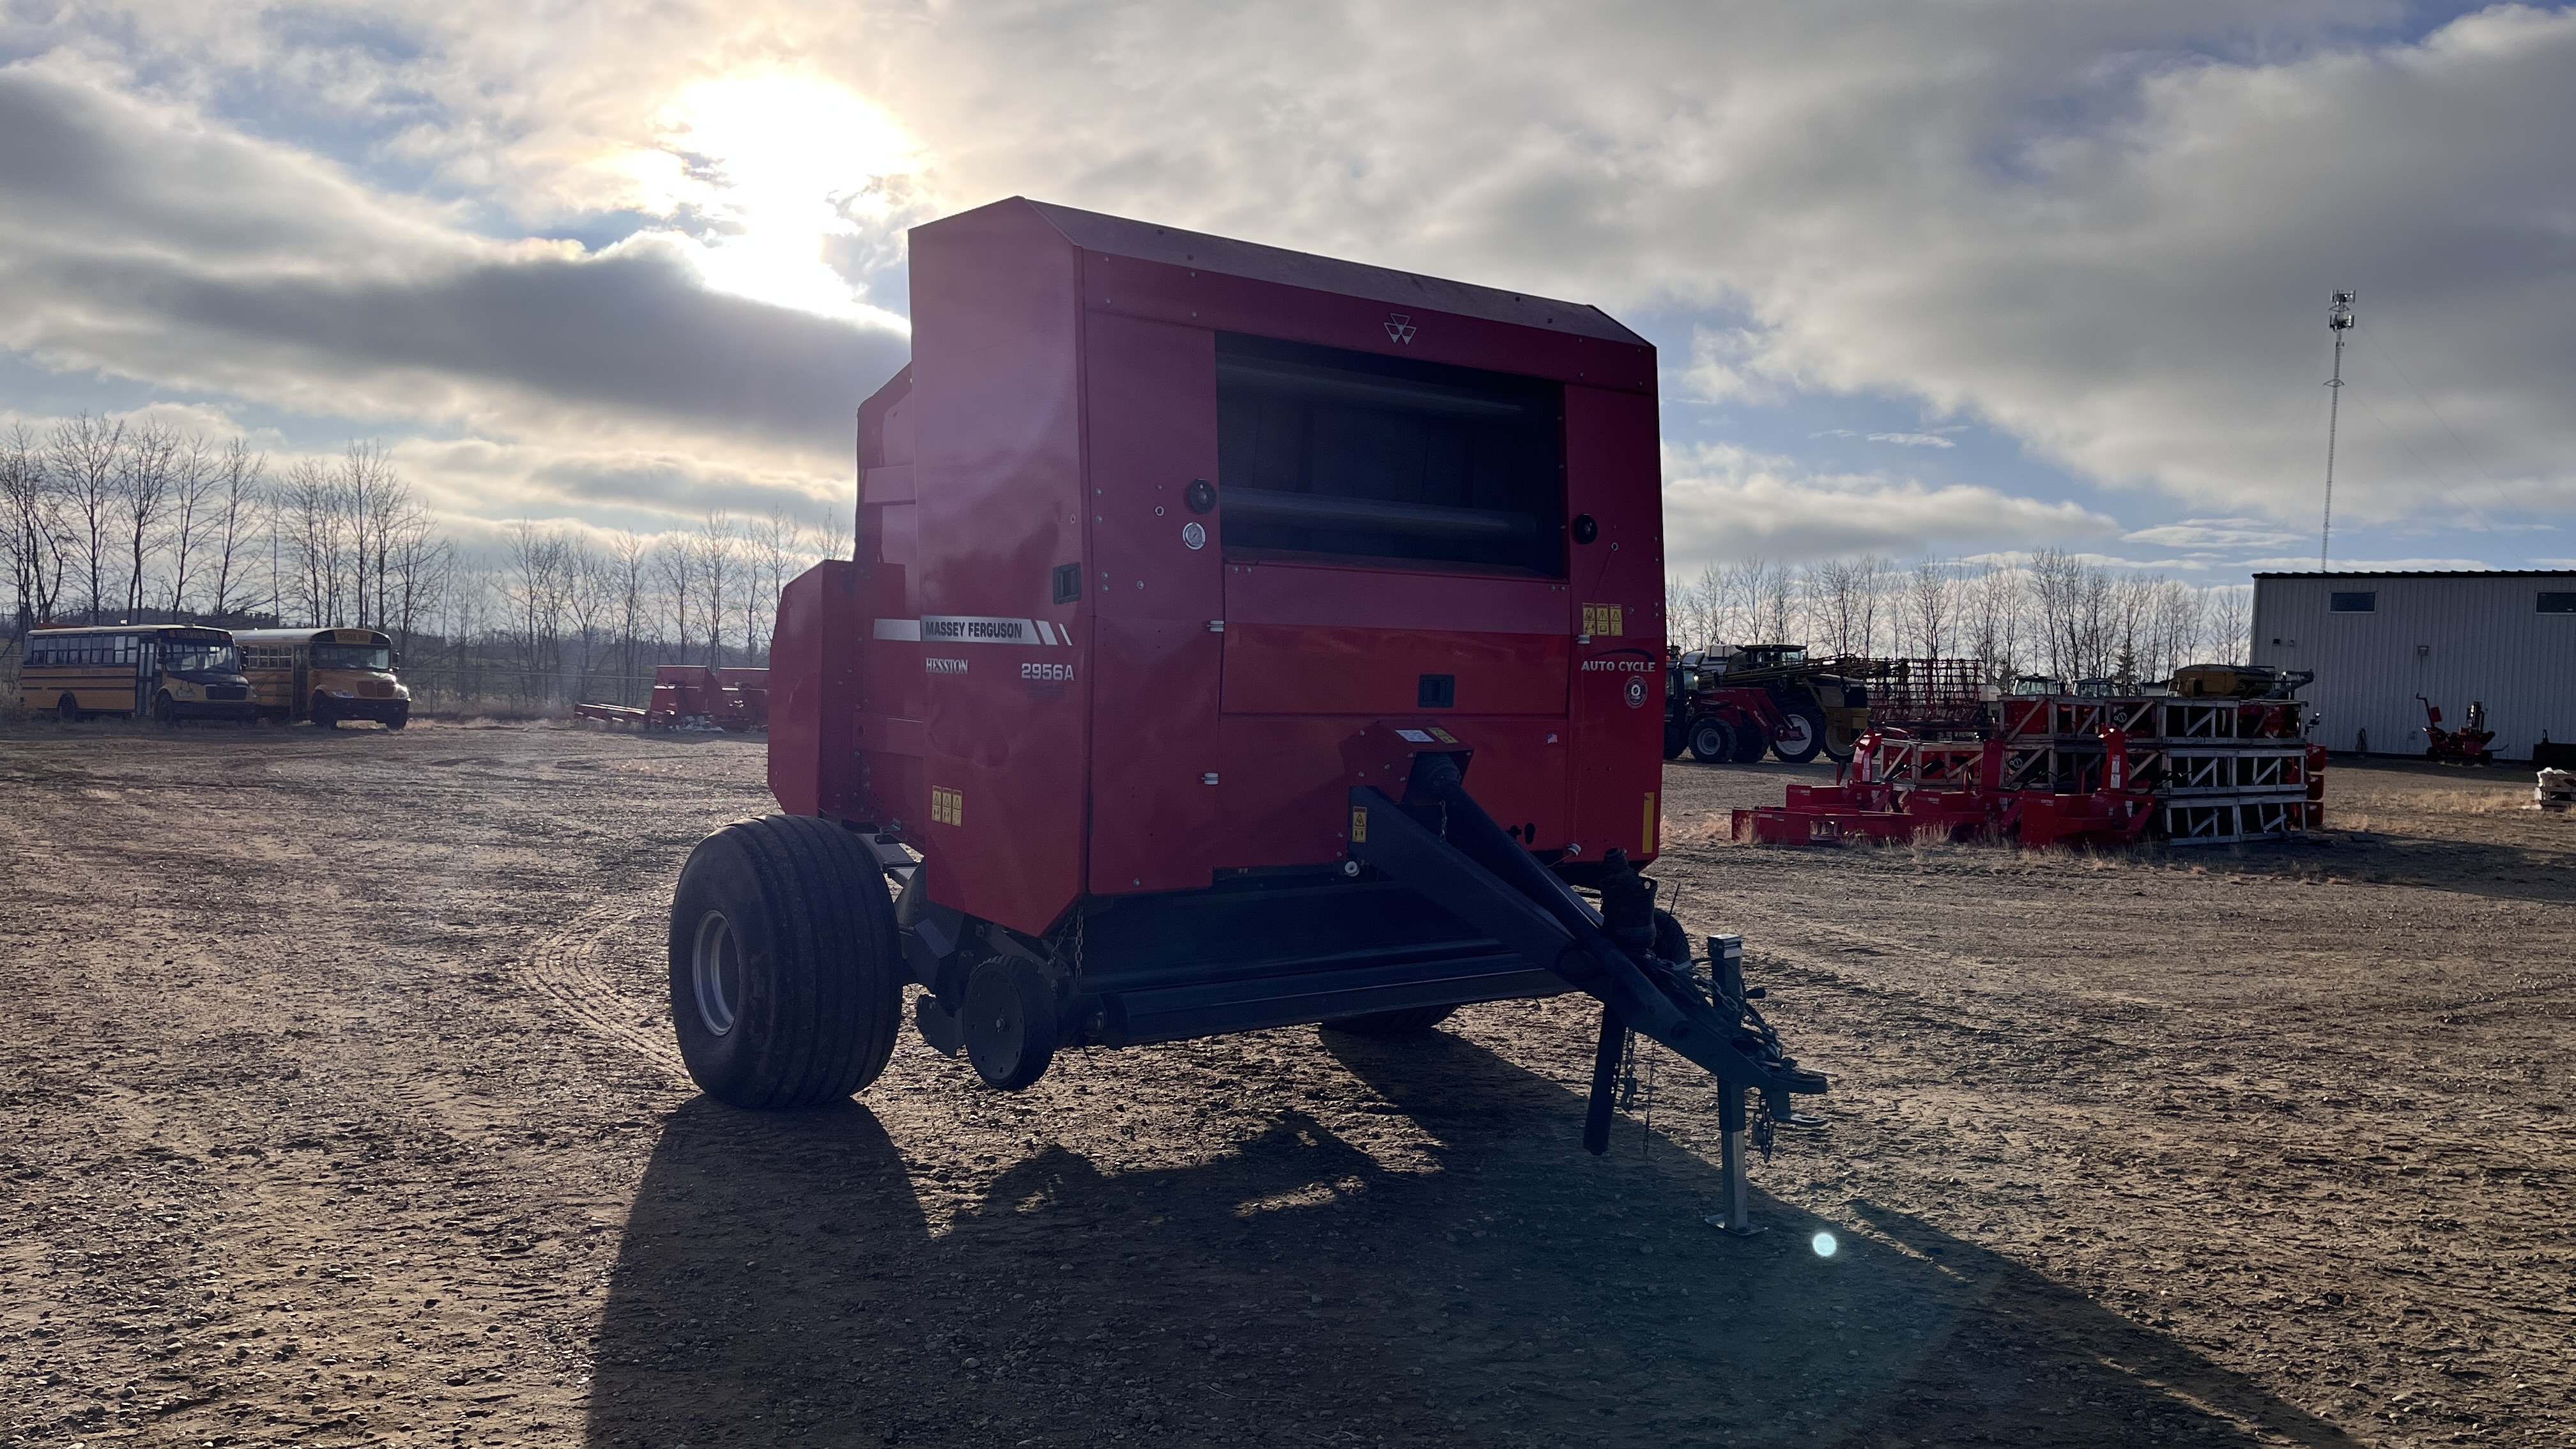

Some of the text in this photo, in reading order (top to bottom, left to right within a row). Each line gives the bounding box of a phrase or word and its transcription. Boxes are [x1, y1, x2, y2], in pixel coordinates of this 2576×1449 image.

[926, 621, 1022, 639] MASSEY FERGUSON
[926, 657, 969, 674] HESSTON
[1021, 663, 1075, 681] 2956A
[1581, 661, 1655, 672] AUTO CYCLE
